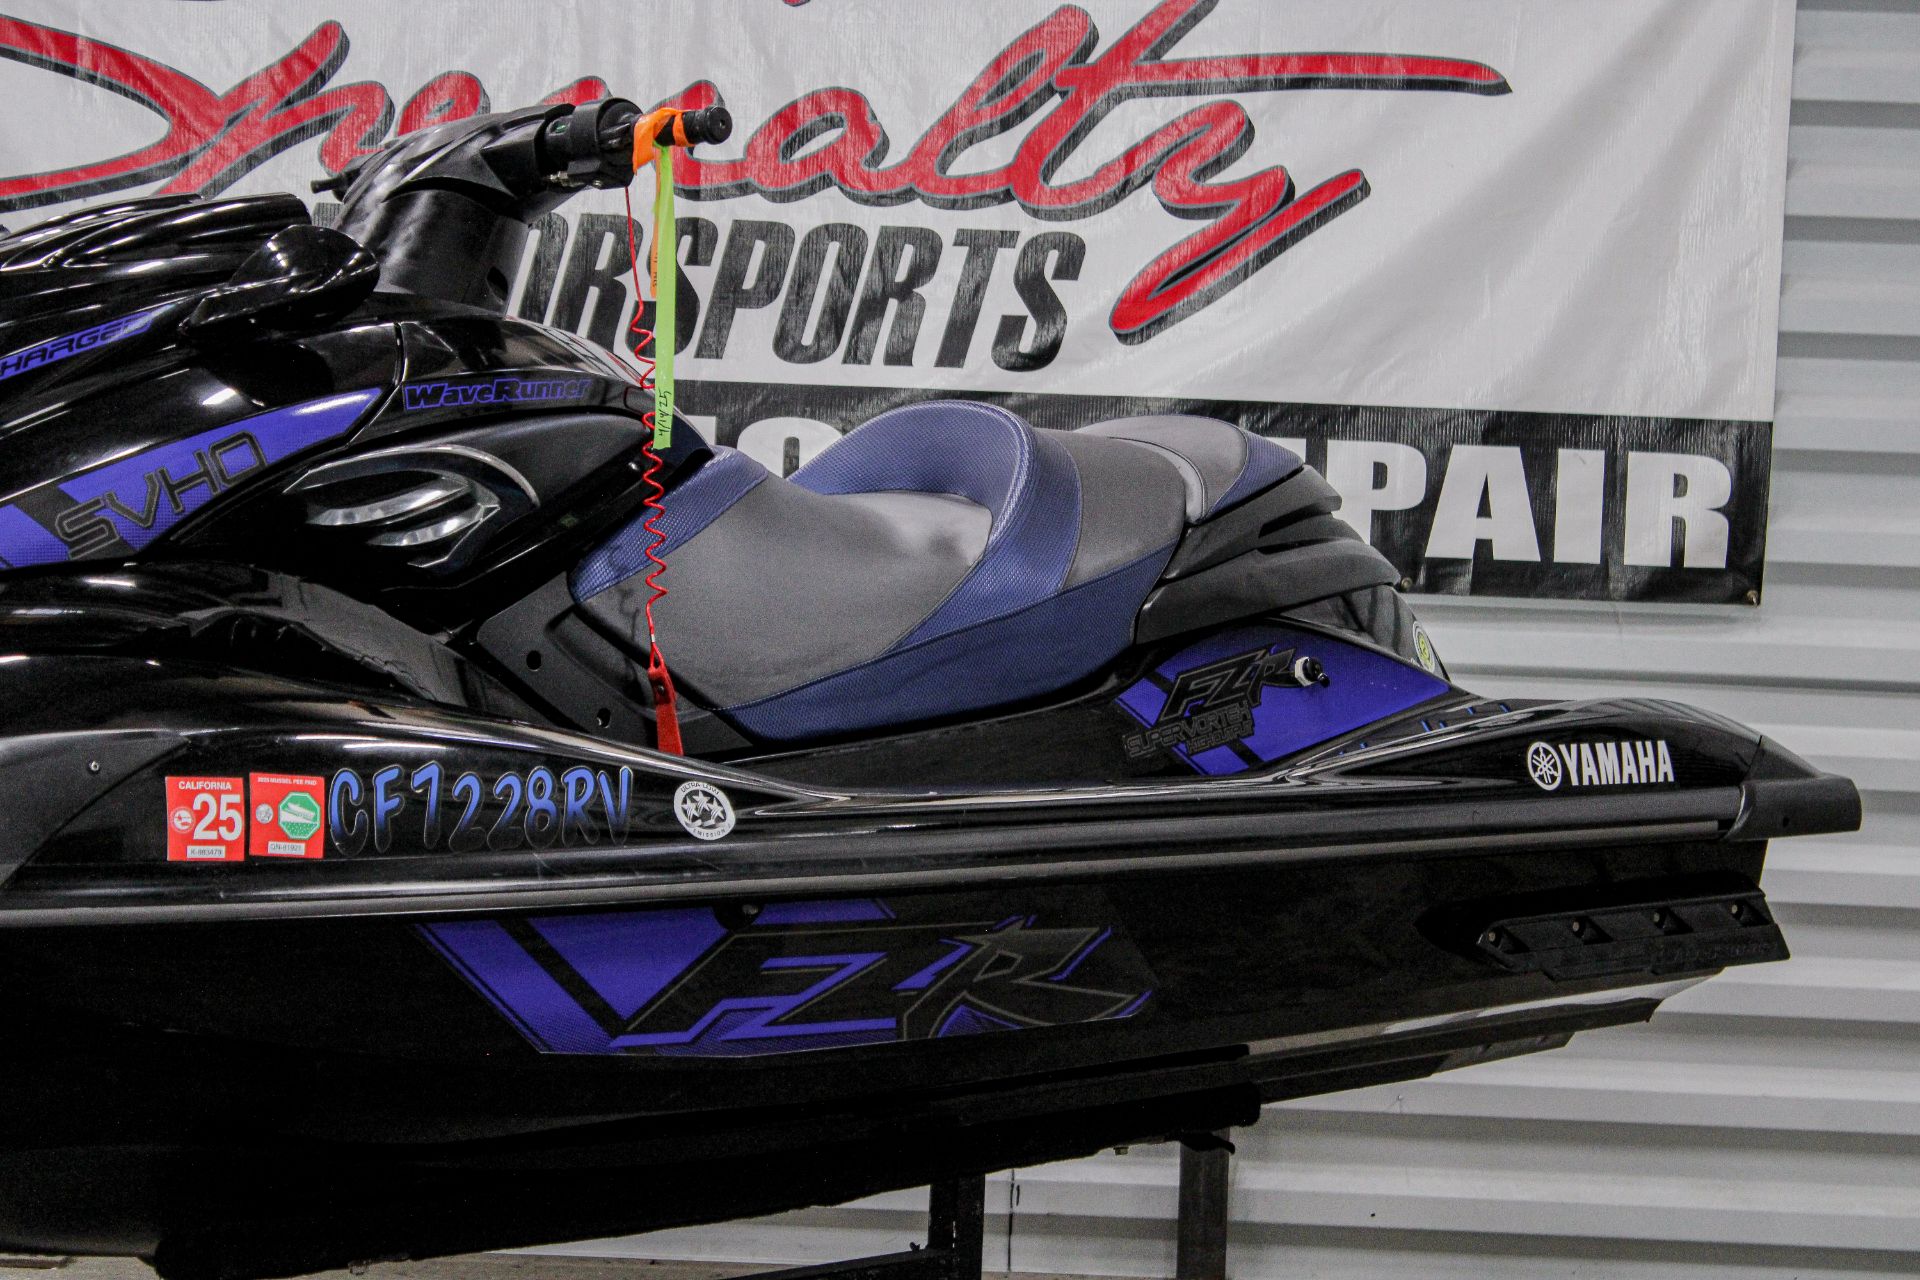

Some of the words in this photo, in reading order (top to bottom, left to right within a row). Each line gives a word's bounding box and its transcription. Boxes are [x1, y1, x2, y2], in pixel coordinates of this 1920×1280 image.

[405, 378, 593, 410] WaveRunner
[55, 431, 268, 560] SVHO
[1265, 436, 1733, 569] PAIR
[178, 780, 232, 790] CALIFORNIA
[1558, 740, 1675, 786] YAMAHA
[192, 793, 243, 841] 25
